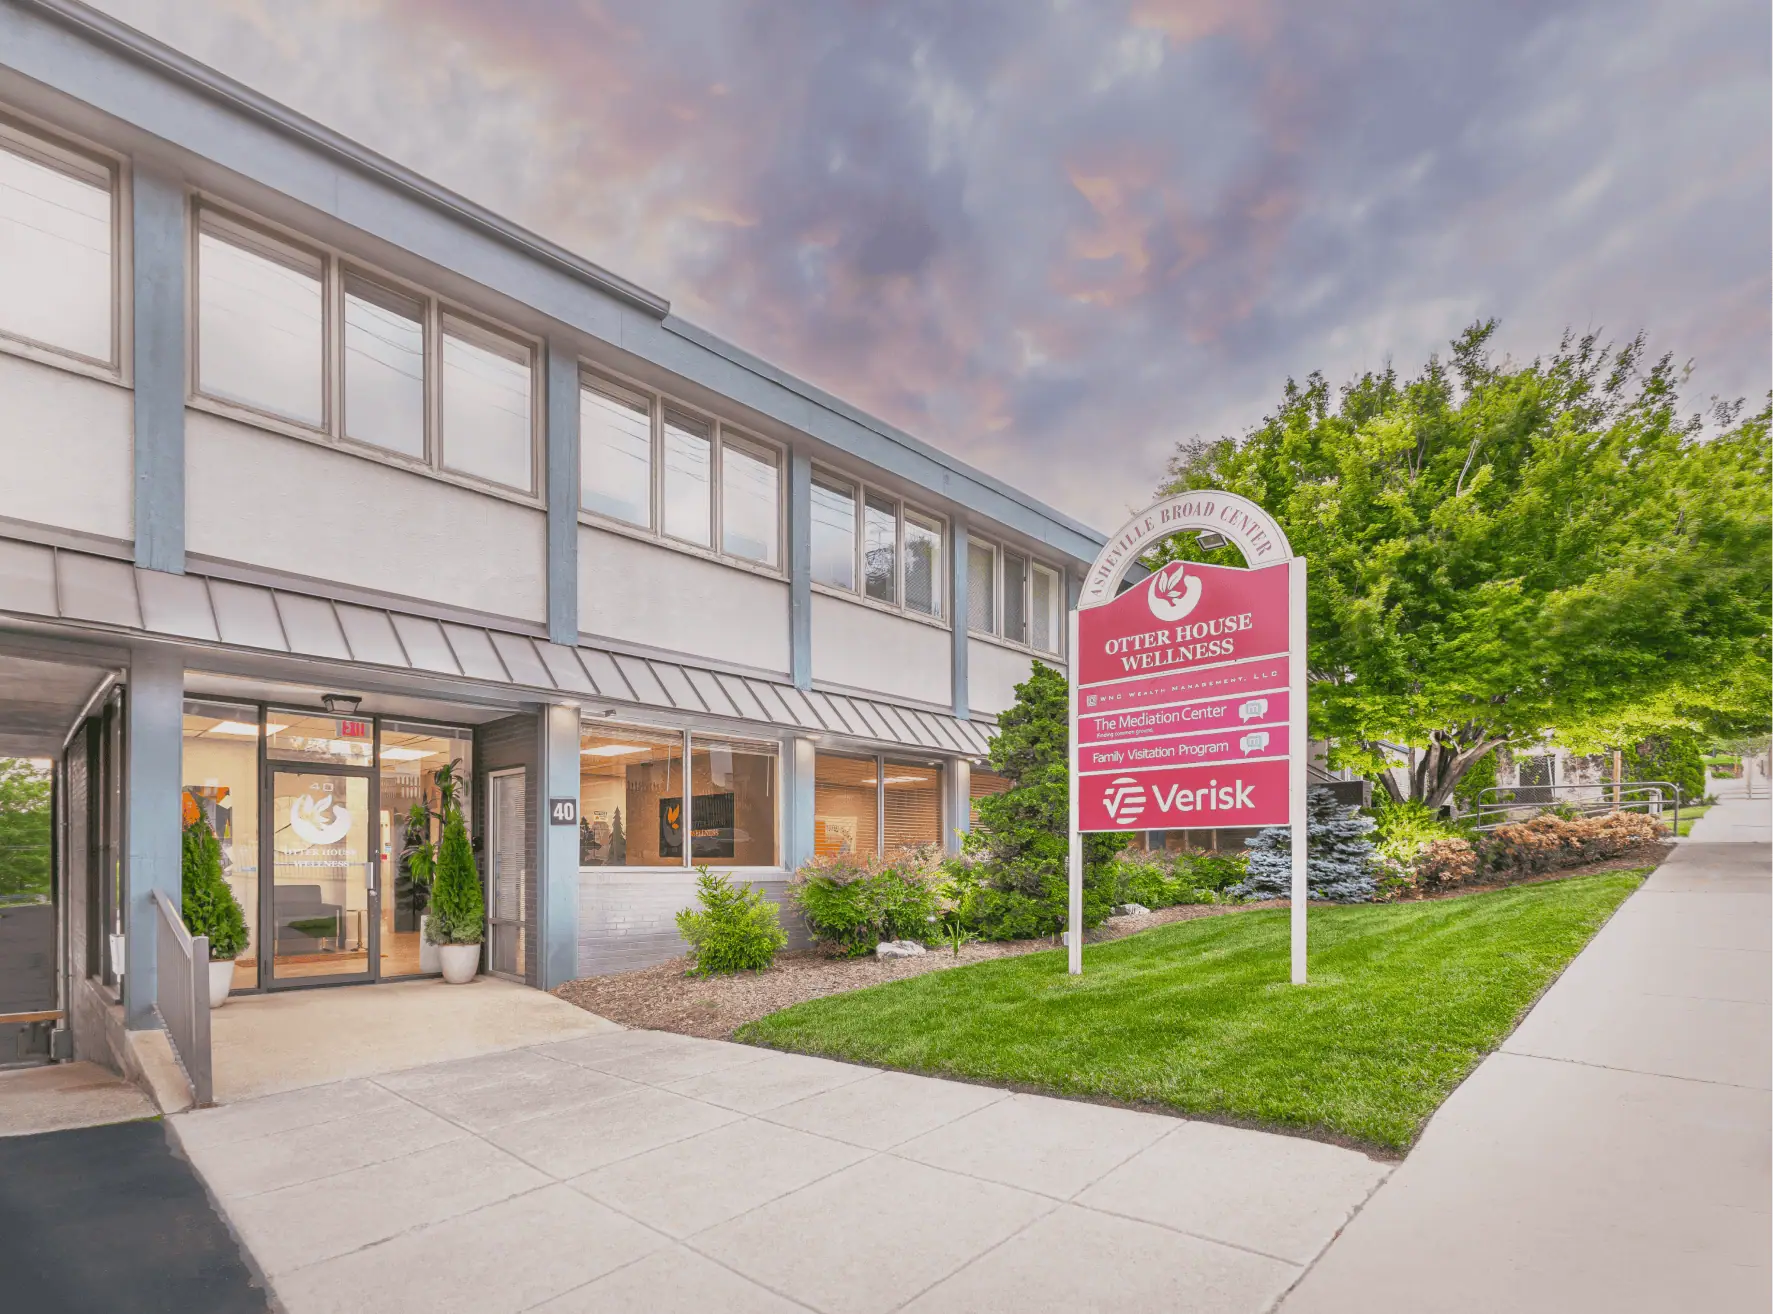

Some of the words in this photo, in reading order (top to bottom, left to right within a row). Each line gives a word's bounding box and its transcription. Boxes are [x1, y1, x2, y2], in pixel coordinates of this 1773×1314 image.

[1091, 516, 1155, 597] ASHEVILLE
[1160, 501, 1215, 524] BROAD
[1220, 505, 1272, 556] CENTER
[1105, 629, 1171, 655] OTTER
[1175, 612, 1253, 643] HOUSE
[1121, 638, 1235, 672] WELLNESS
[1100, 694, 1122, 702] WNC
[1129, 688, 1165, 697] WEALTH
[1253, 670, 1278, 679] LLC
[1094, 718, 1116, 730] The
[1119, 711, 1180, 729] Mediation
[1181, 705, 1227, 720] Center
[1093, 751, 1124, 763] Family
[1128, 747, 1175, 760] Visitation
[1179, 742, 1229, 756] Program
[310, 783, 334, 792] 40
[1151, 779, 1256, 812] Verisk
[553, 802, 575, 820] 40
